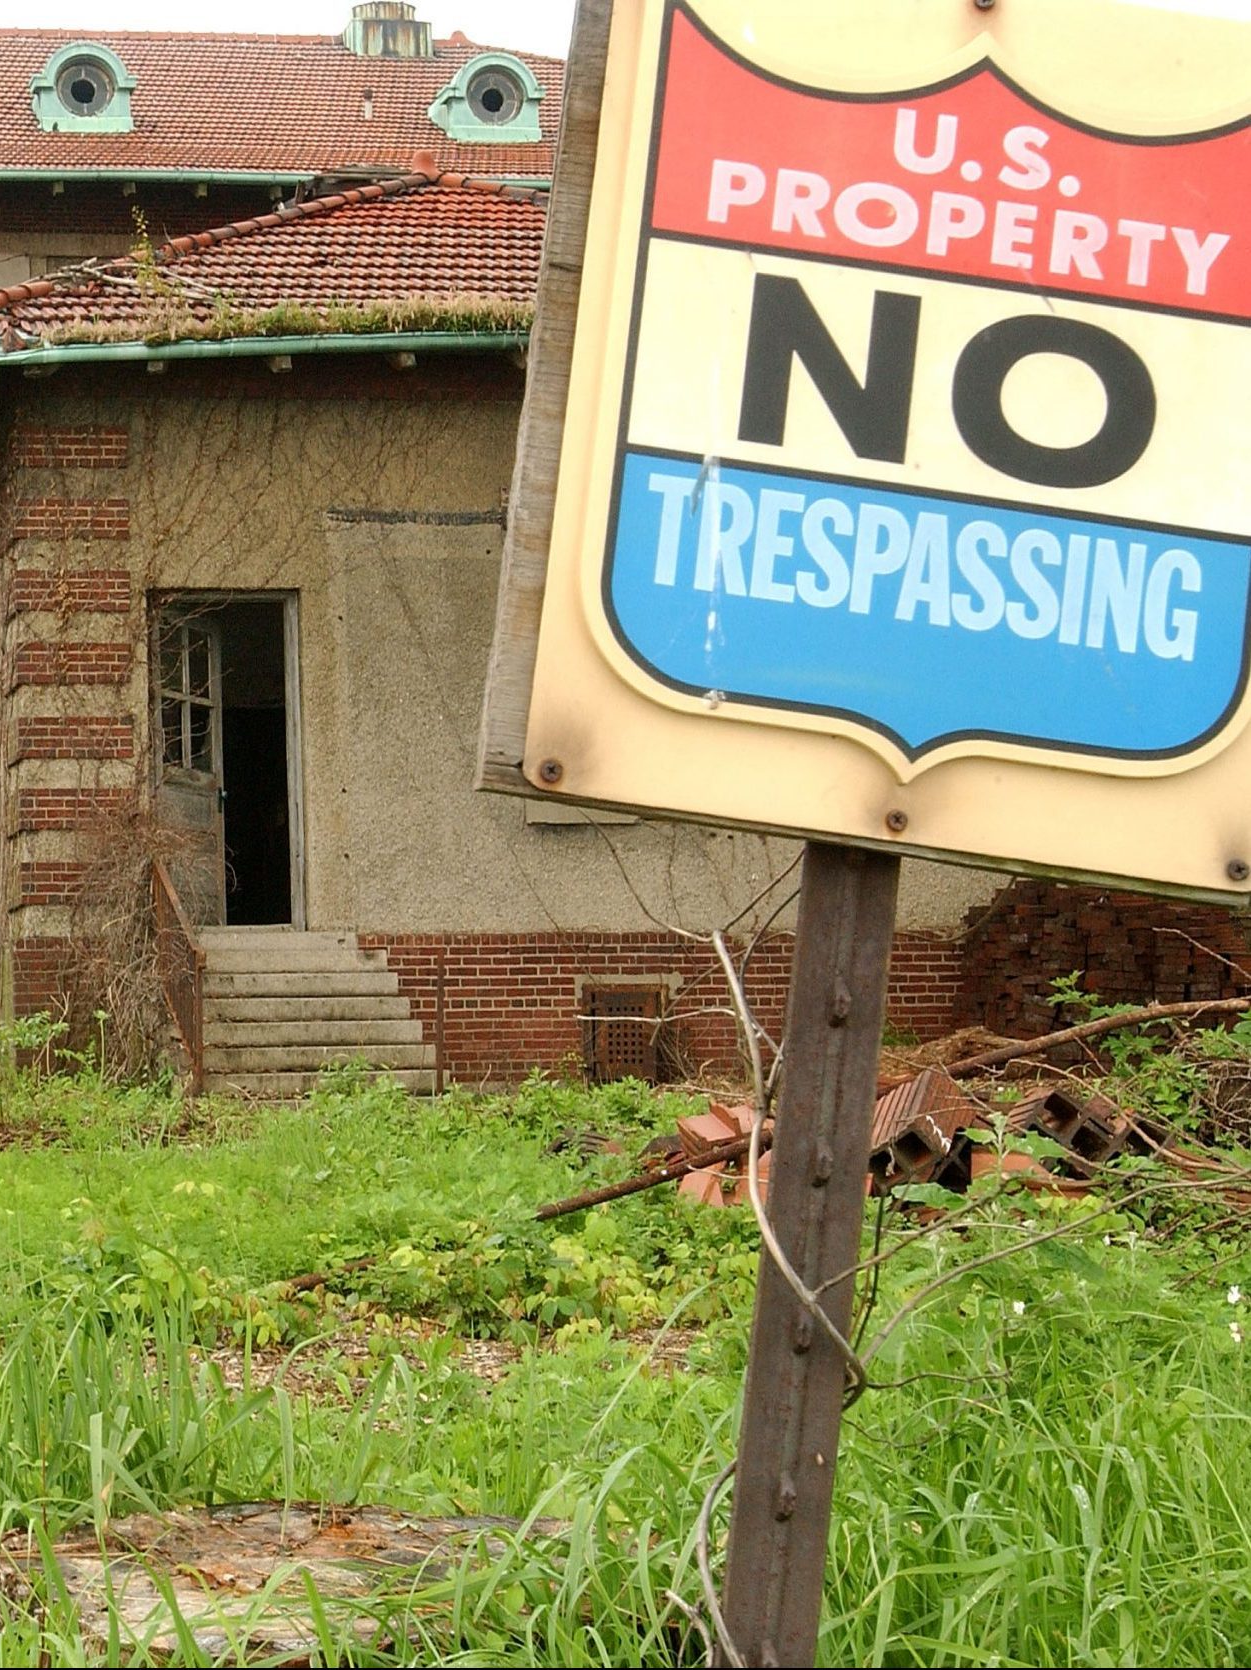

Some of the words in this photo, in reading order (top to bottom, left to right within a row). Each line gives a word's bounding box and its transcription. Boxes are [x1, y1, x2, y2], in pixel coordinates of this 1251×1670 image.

[706, 159, 1231, 295] PROPERTY
[893, 108, 1080, 196] U.S.
[737, 272, 1157, 489] NO
[648, 472, 1202, 663] TRESPASSING
